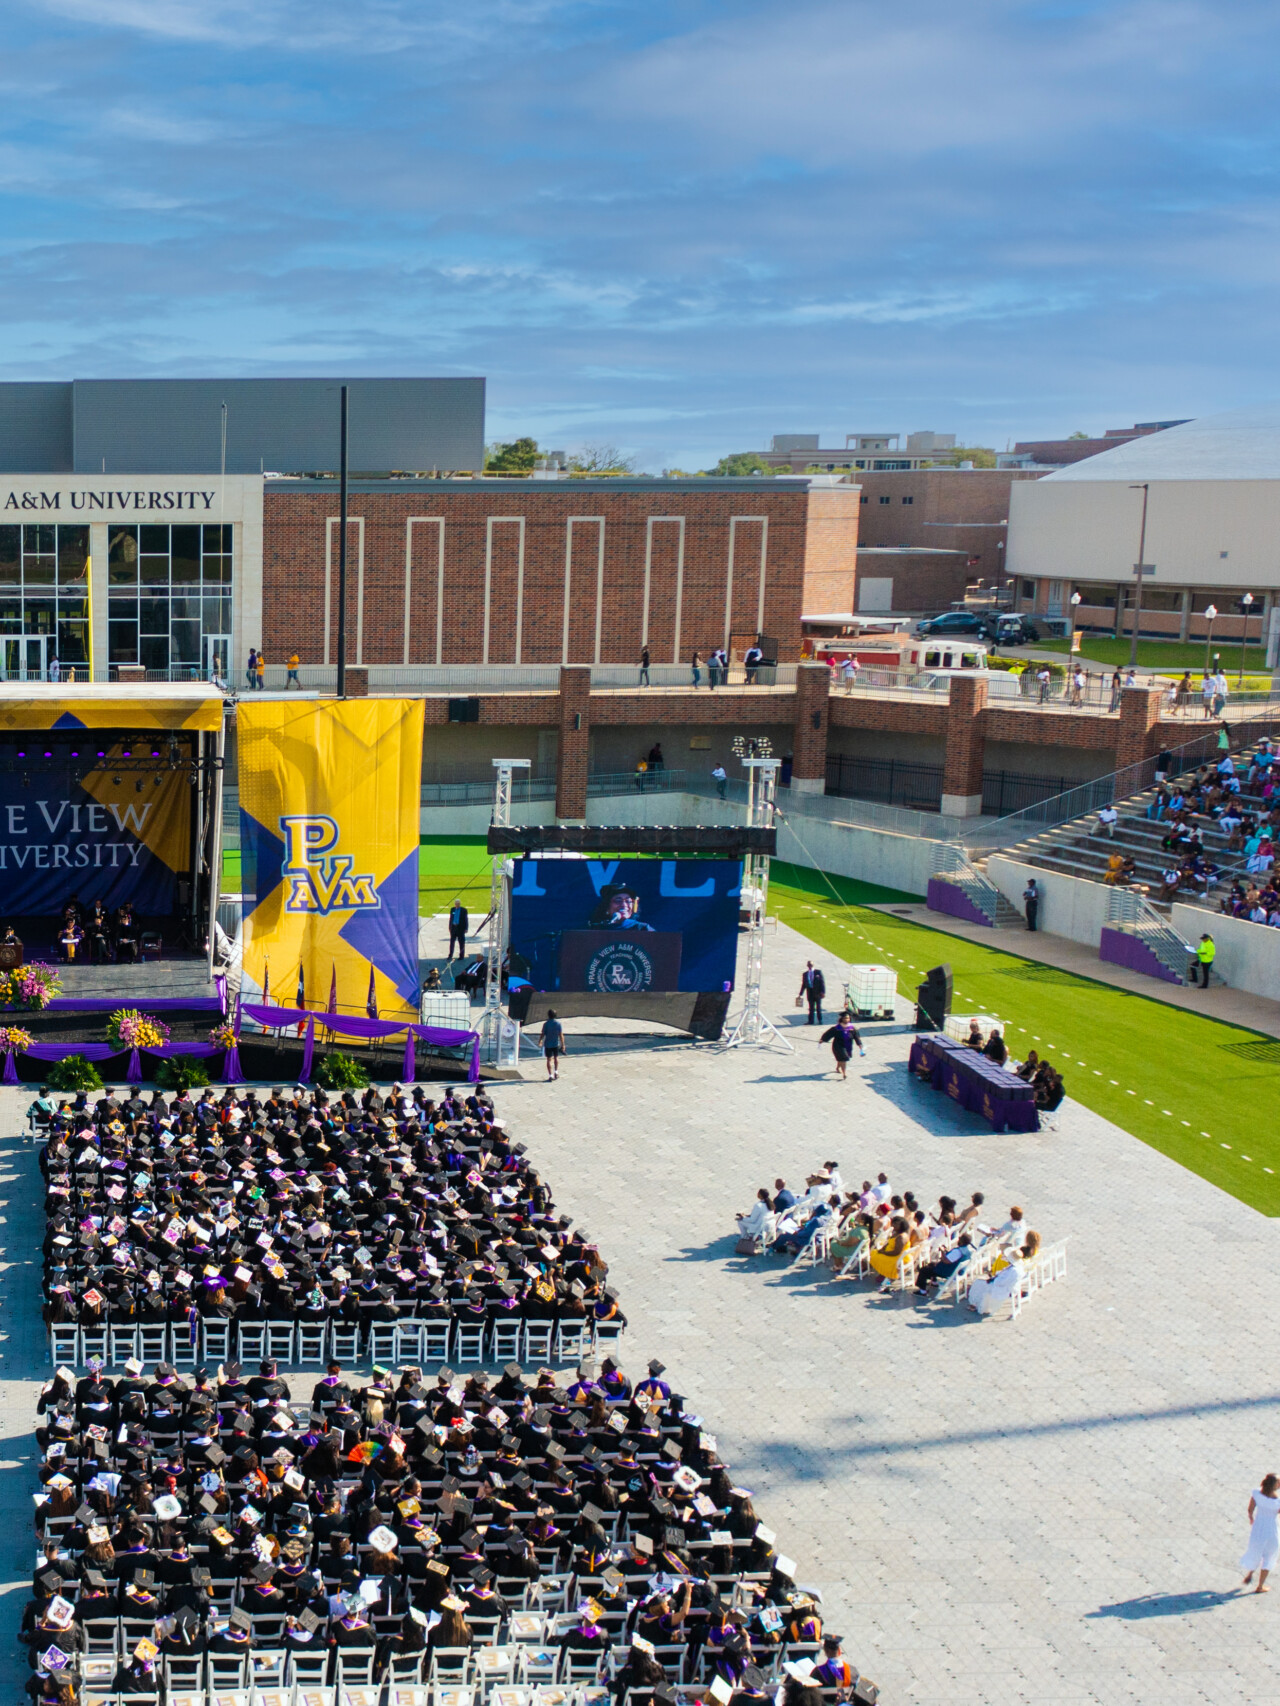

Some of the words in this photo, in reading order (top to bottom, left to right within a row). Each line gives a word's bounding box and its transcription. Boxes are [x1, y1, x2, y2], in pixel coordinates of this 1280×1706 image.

[4, 491, 61, 510] A&M
[69, 491, 216, 510] UNIVERSITY
[35, 800, 153, 834] VIEW
[599, 945, 615, 957] VIEW
